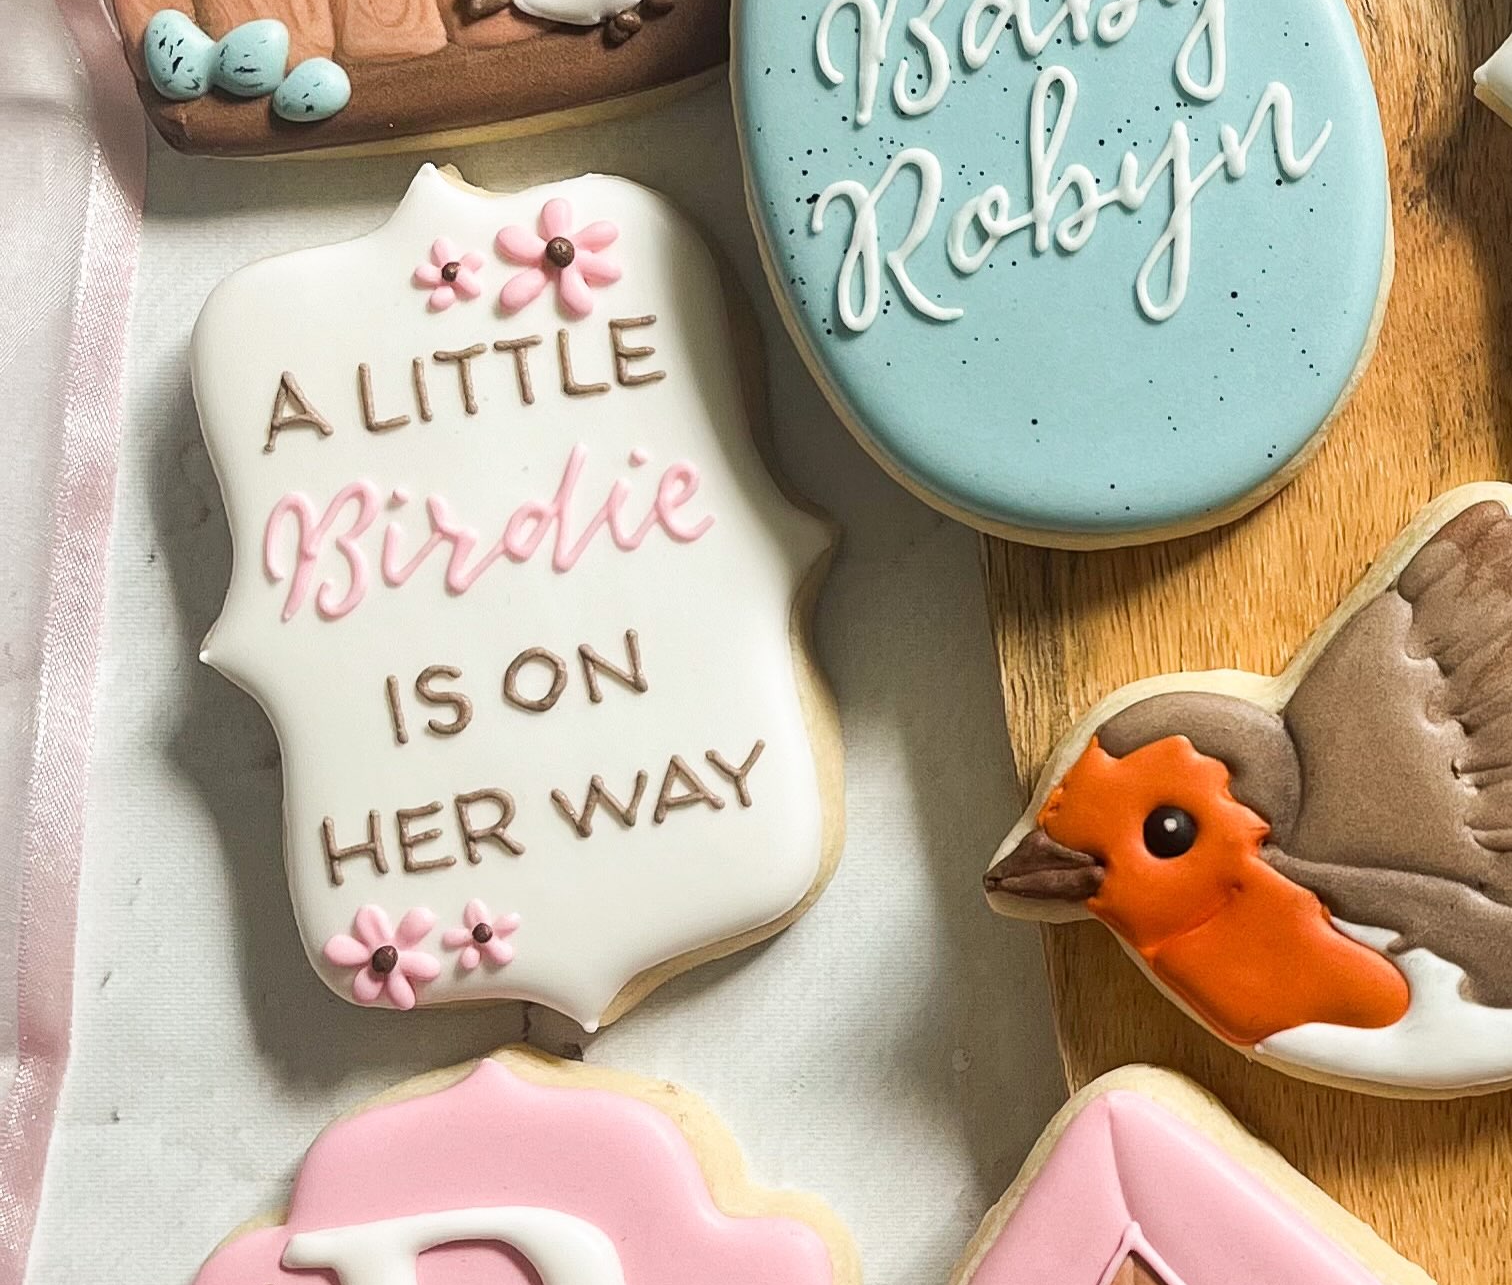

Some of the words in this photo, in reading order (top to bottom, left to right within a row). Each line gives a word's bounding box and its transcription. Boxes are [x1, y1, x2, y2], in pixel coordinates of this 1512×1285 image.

[812, 66, 1332, 331] Robyn
[263, 370, 333, 453] A
[357, 313, 667, 432] LITTLE
[264, 443, 715, 622] Birdie
[385, 663, 473, 745] IS
[502, 628, 648, 713] ON
[321, 786, 526, 887] HER
[550, 739, 767, 839] WAY
